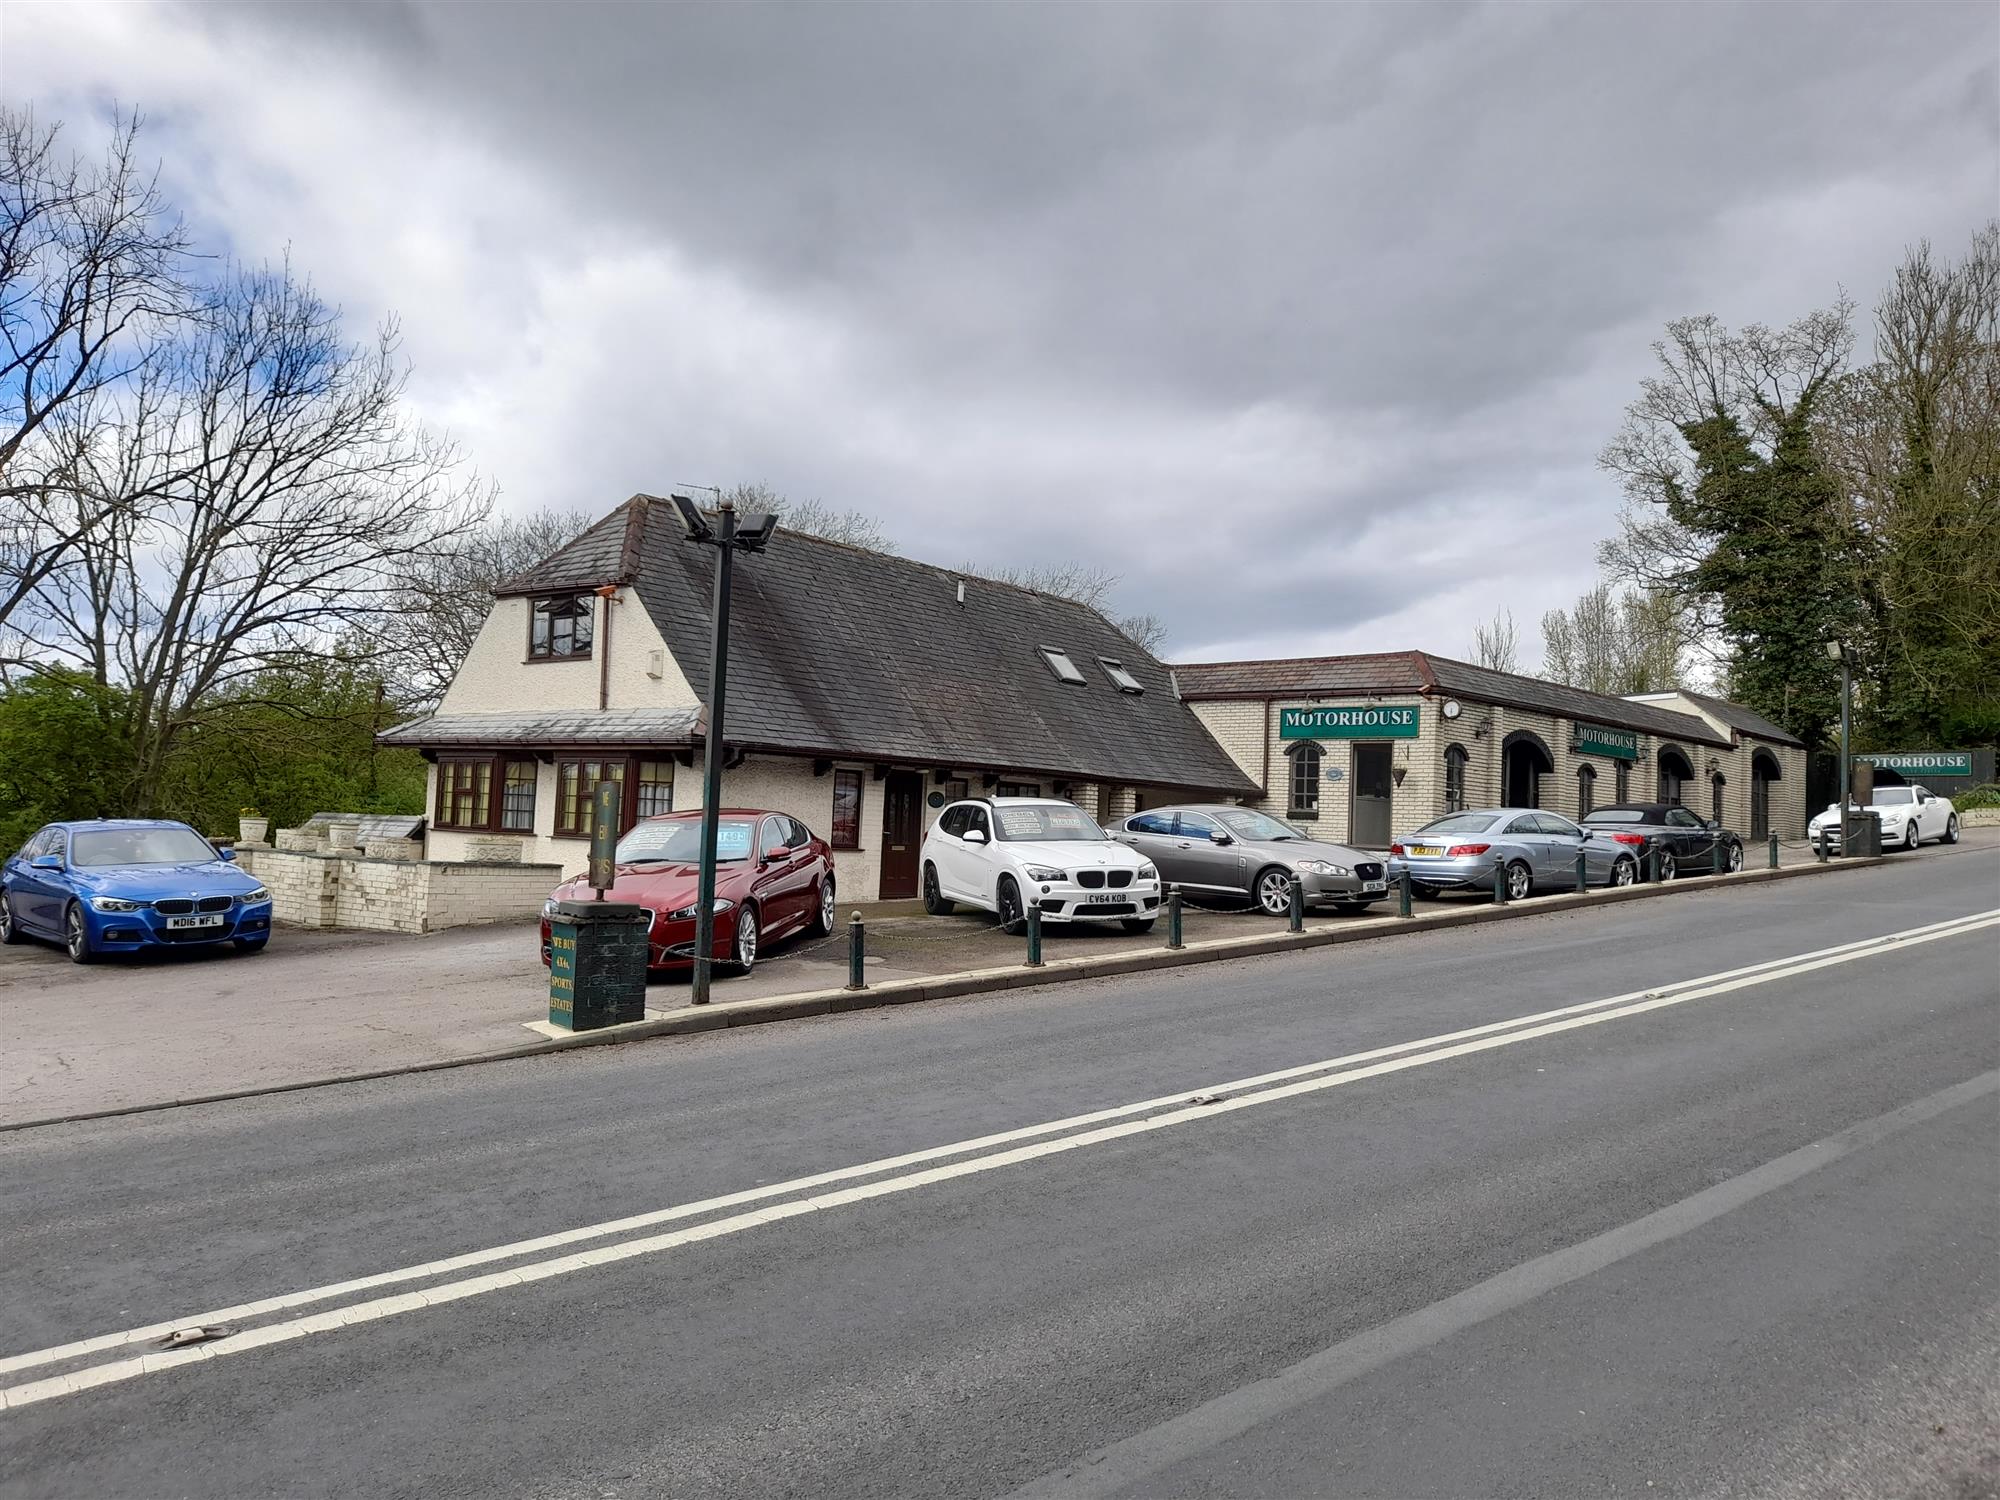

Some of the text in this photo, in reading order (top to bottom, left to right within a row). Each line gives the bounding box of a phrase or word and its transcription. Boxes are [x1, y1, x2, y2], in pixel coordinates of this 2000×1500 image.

[1285, 710, 1413, 727] MOTORHOUSE
[1580, 727, 1635, 749] MOTORHOUSE
[552, 936, 576, 951] WE BUY
